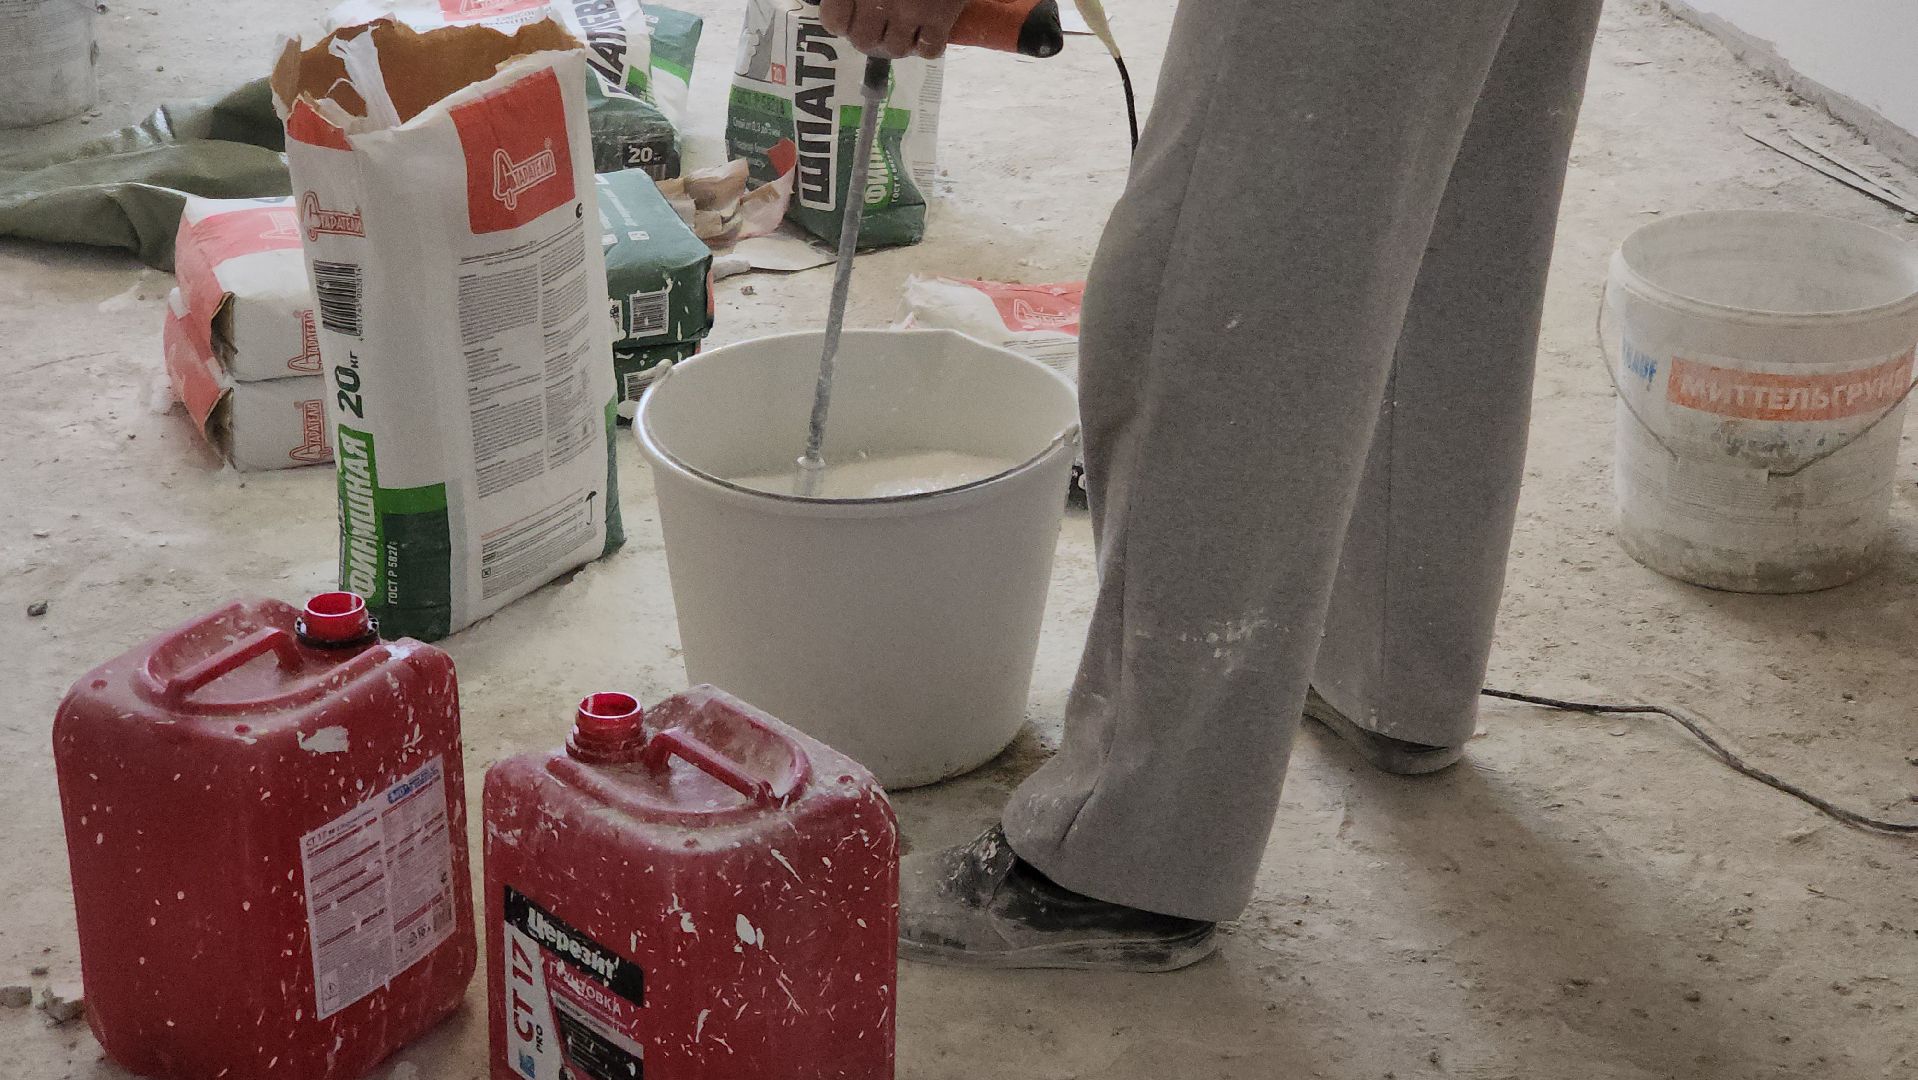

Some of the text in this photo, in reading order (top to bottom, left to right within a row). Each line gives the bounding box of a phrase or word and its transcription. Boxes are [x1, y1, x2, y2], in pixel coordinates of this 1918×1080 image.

[795, 17, 838, 203] ШПАТЛ
[628, 148, 653, 163] 20
[335, 366, 363, 419] 20
[340, 431, 378, 599] ФИНИШНАЯ
[388, 569, 397, 578] Р
[388, 580, 398, 605] ГОСТ
[512, 935, 533, 986] 17
[535, 1023, 544, 1054] PRO
